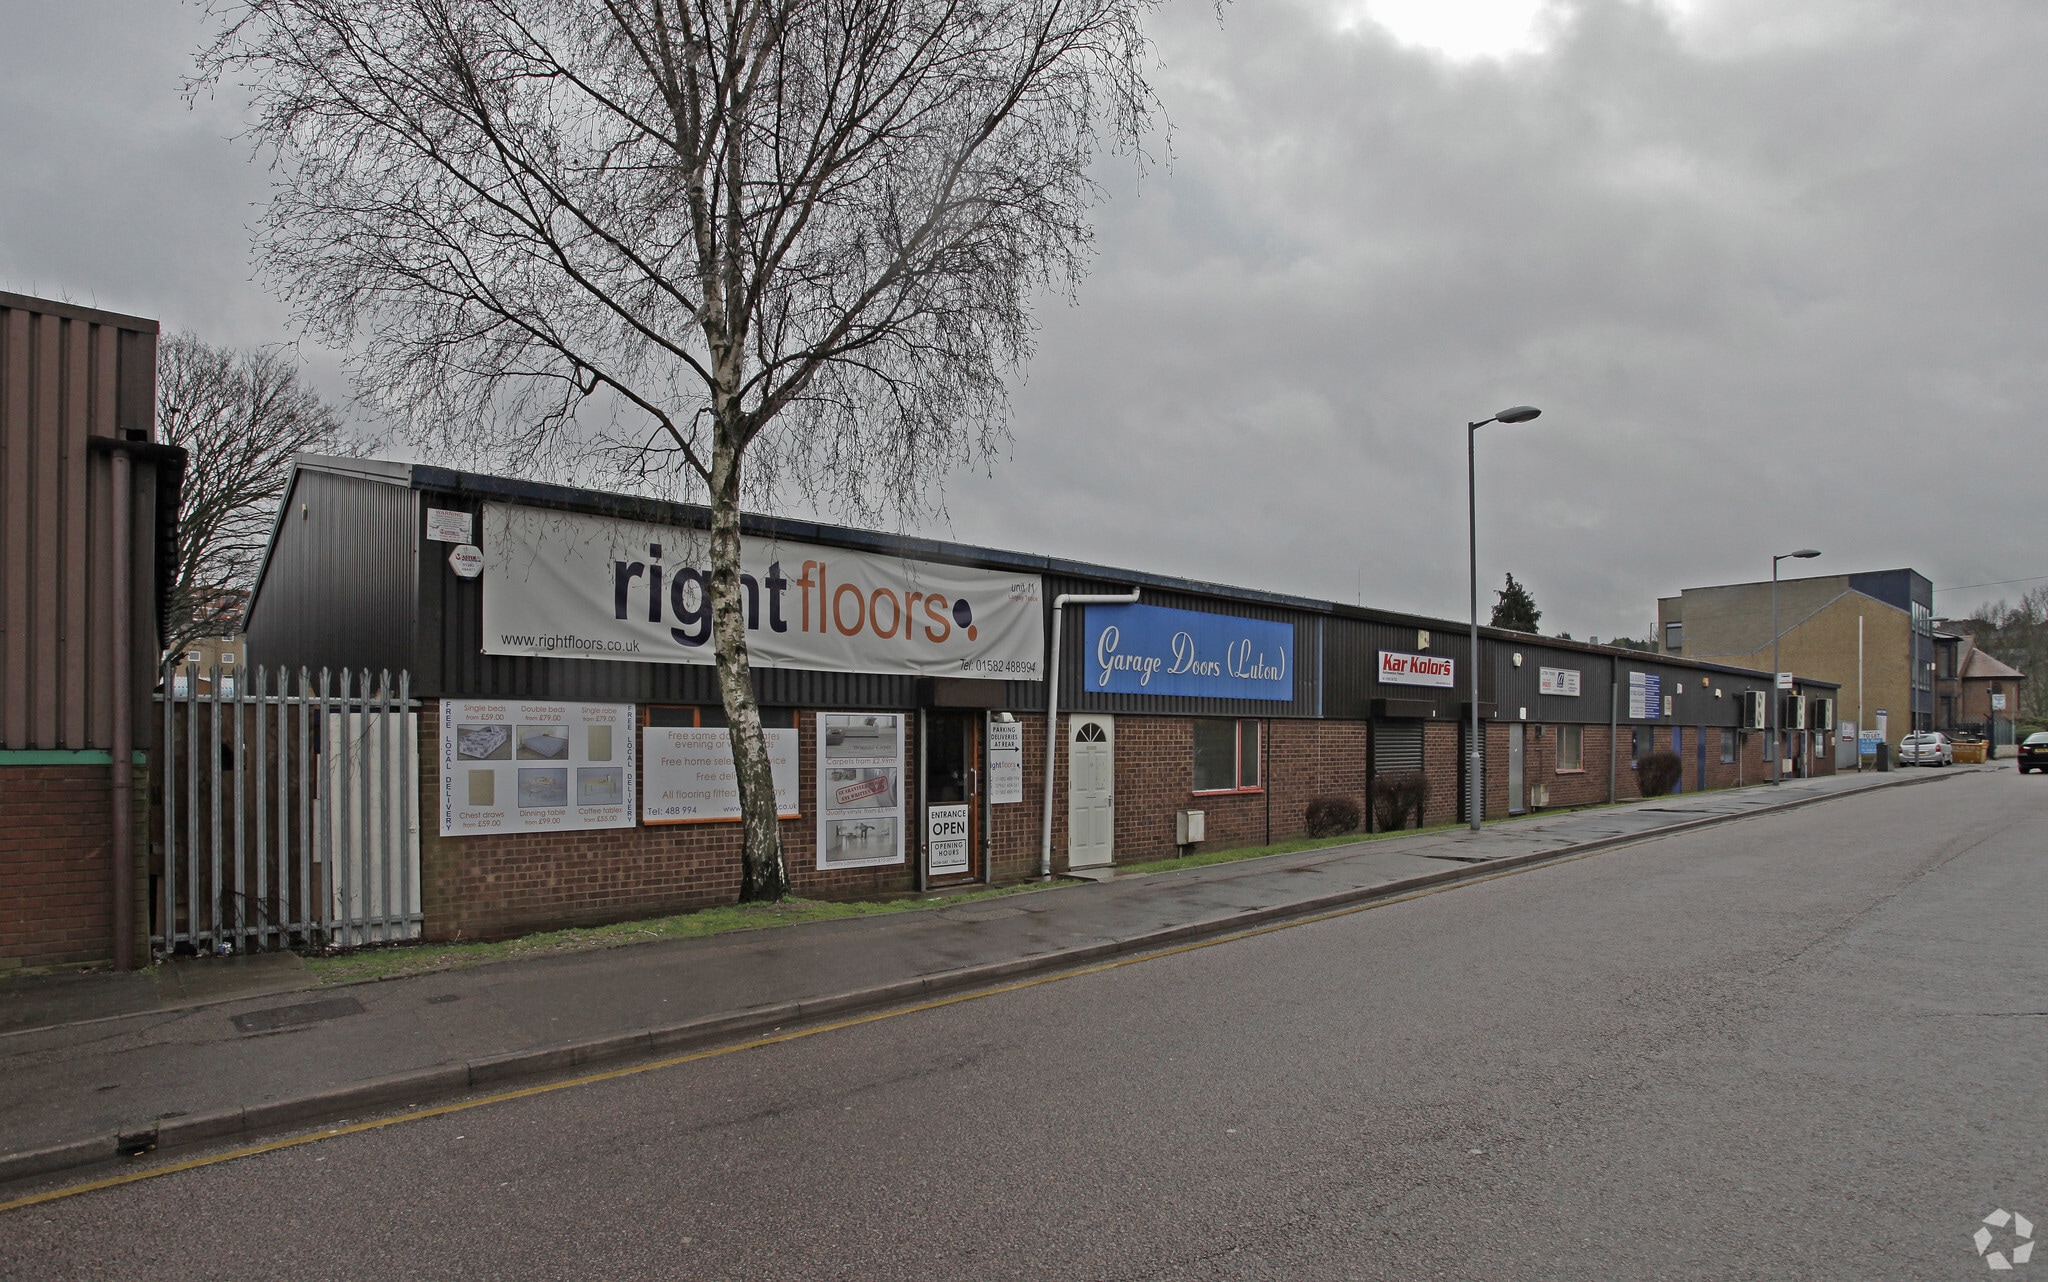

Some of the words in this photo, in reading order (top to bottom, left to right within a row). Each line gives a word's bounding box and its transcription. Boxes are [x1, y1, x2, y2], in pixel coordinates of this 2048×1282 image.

[500, 634, 640, 652] www.rightfloors.co.uk
[1097, 625, 1161, 687] Garage
[1167, 631, 1220, 677] Doors
[1227, 638, 1285, 681] (Luton)
[960, 658, 974, 671] Tel:
[976, 659, 1004, 672] 01582
[1006, 660, 1036, 673] 488994
[1383, 653, 1408, 672] Kar
[1409, 656, 1451, 676] Kolors
[463, 704, 486, 713] Single
[488, 704, 506, 712] beds
[581, 706, 601, 715] Single
[668, 731, 689, 740] Free
[675, 741, 714, 750] evening
[716, 741, 725, 749] or
[661, 758, 682, 766] Free
[684, 757, 712, 766] home
[826, 758, 854, 766] Carpets
[856, 757, 871, 765] from
[696, 773, 717, 781] Free
[662, 791, 674, 799] All
[676, 790, 711, 800] flooring
[713, 789, 737, 798] fitted
[647, 807, 663, 816] Tel:
[665, 807, 680, 815] 488
[682, 806, 697, 814] 994
[931, 810, 966, 819] ENTRANCE
[477, 820, 501, 828] £59.00
[933, 821, 965, 835] OPEN
[935, 842, 963, 850] OPENING
